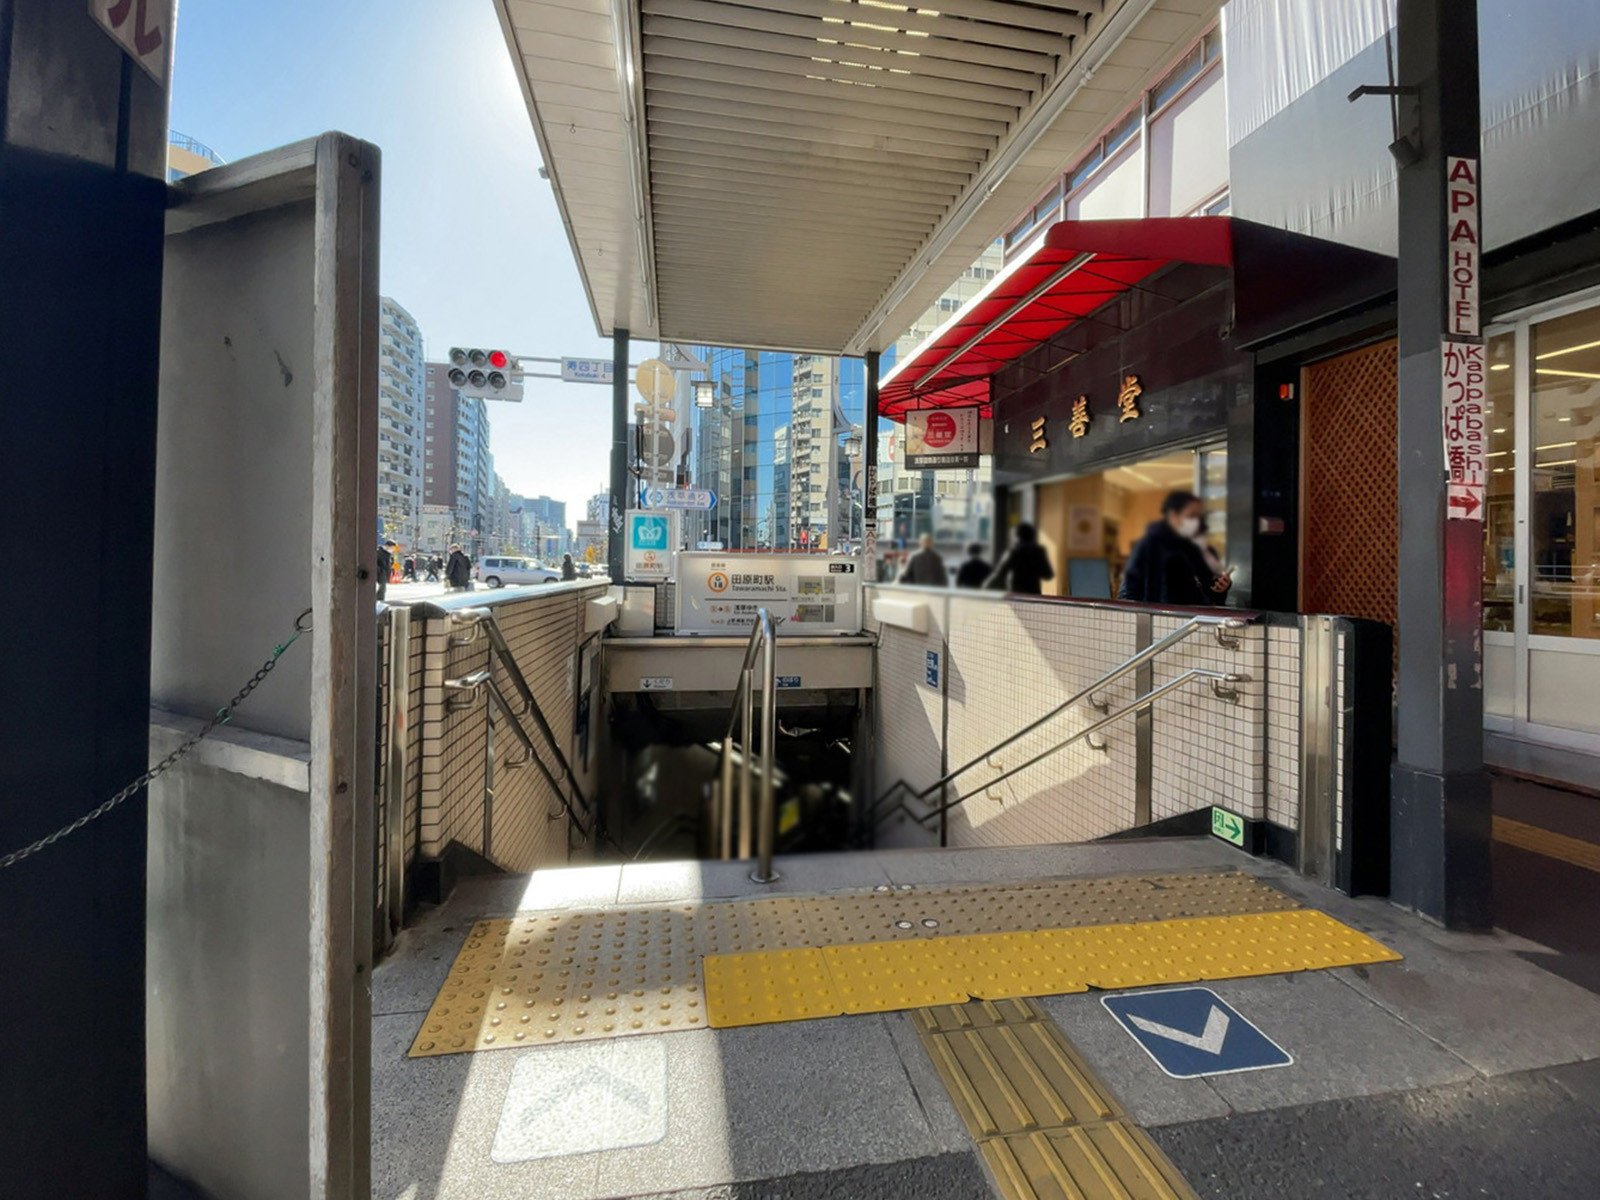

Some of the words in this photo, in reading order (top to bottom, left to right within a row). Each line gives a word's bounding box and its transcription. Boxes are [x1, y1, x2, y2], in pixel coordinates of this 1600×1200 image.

[1449, 160, 1476, 244] APA
[1453, 251, 1473, 334] HOTEL
[1029, 376, 1142, 453] 三善堂
[1466, 345, 1484, 484] Kappabashi
[731, 574, 774, 585] 田原町駅
